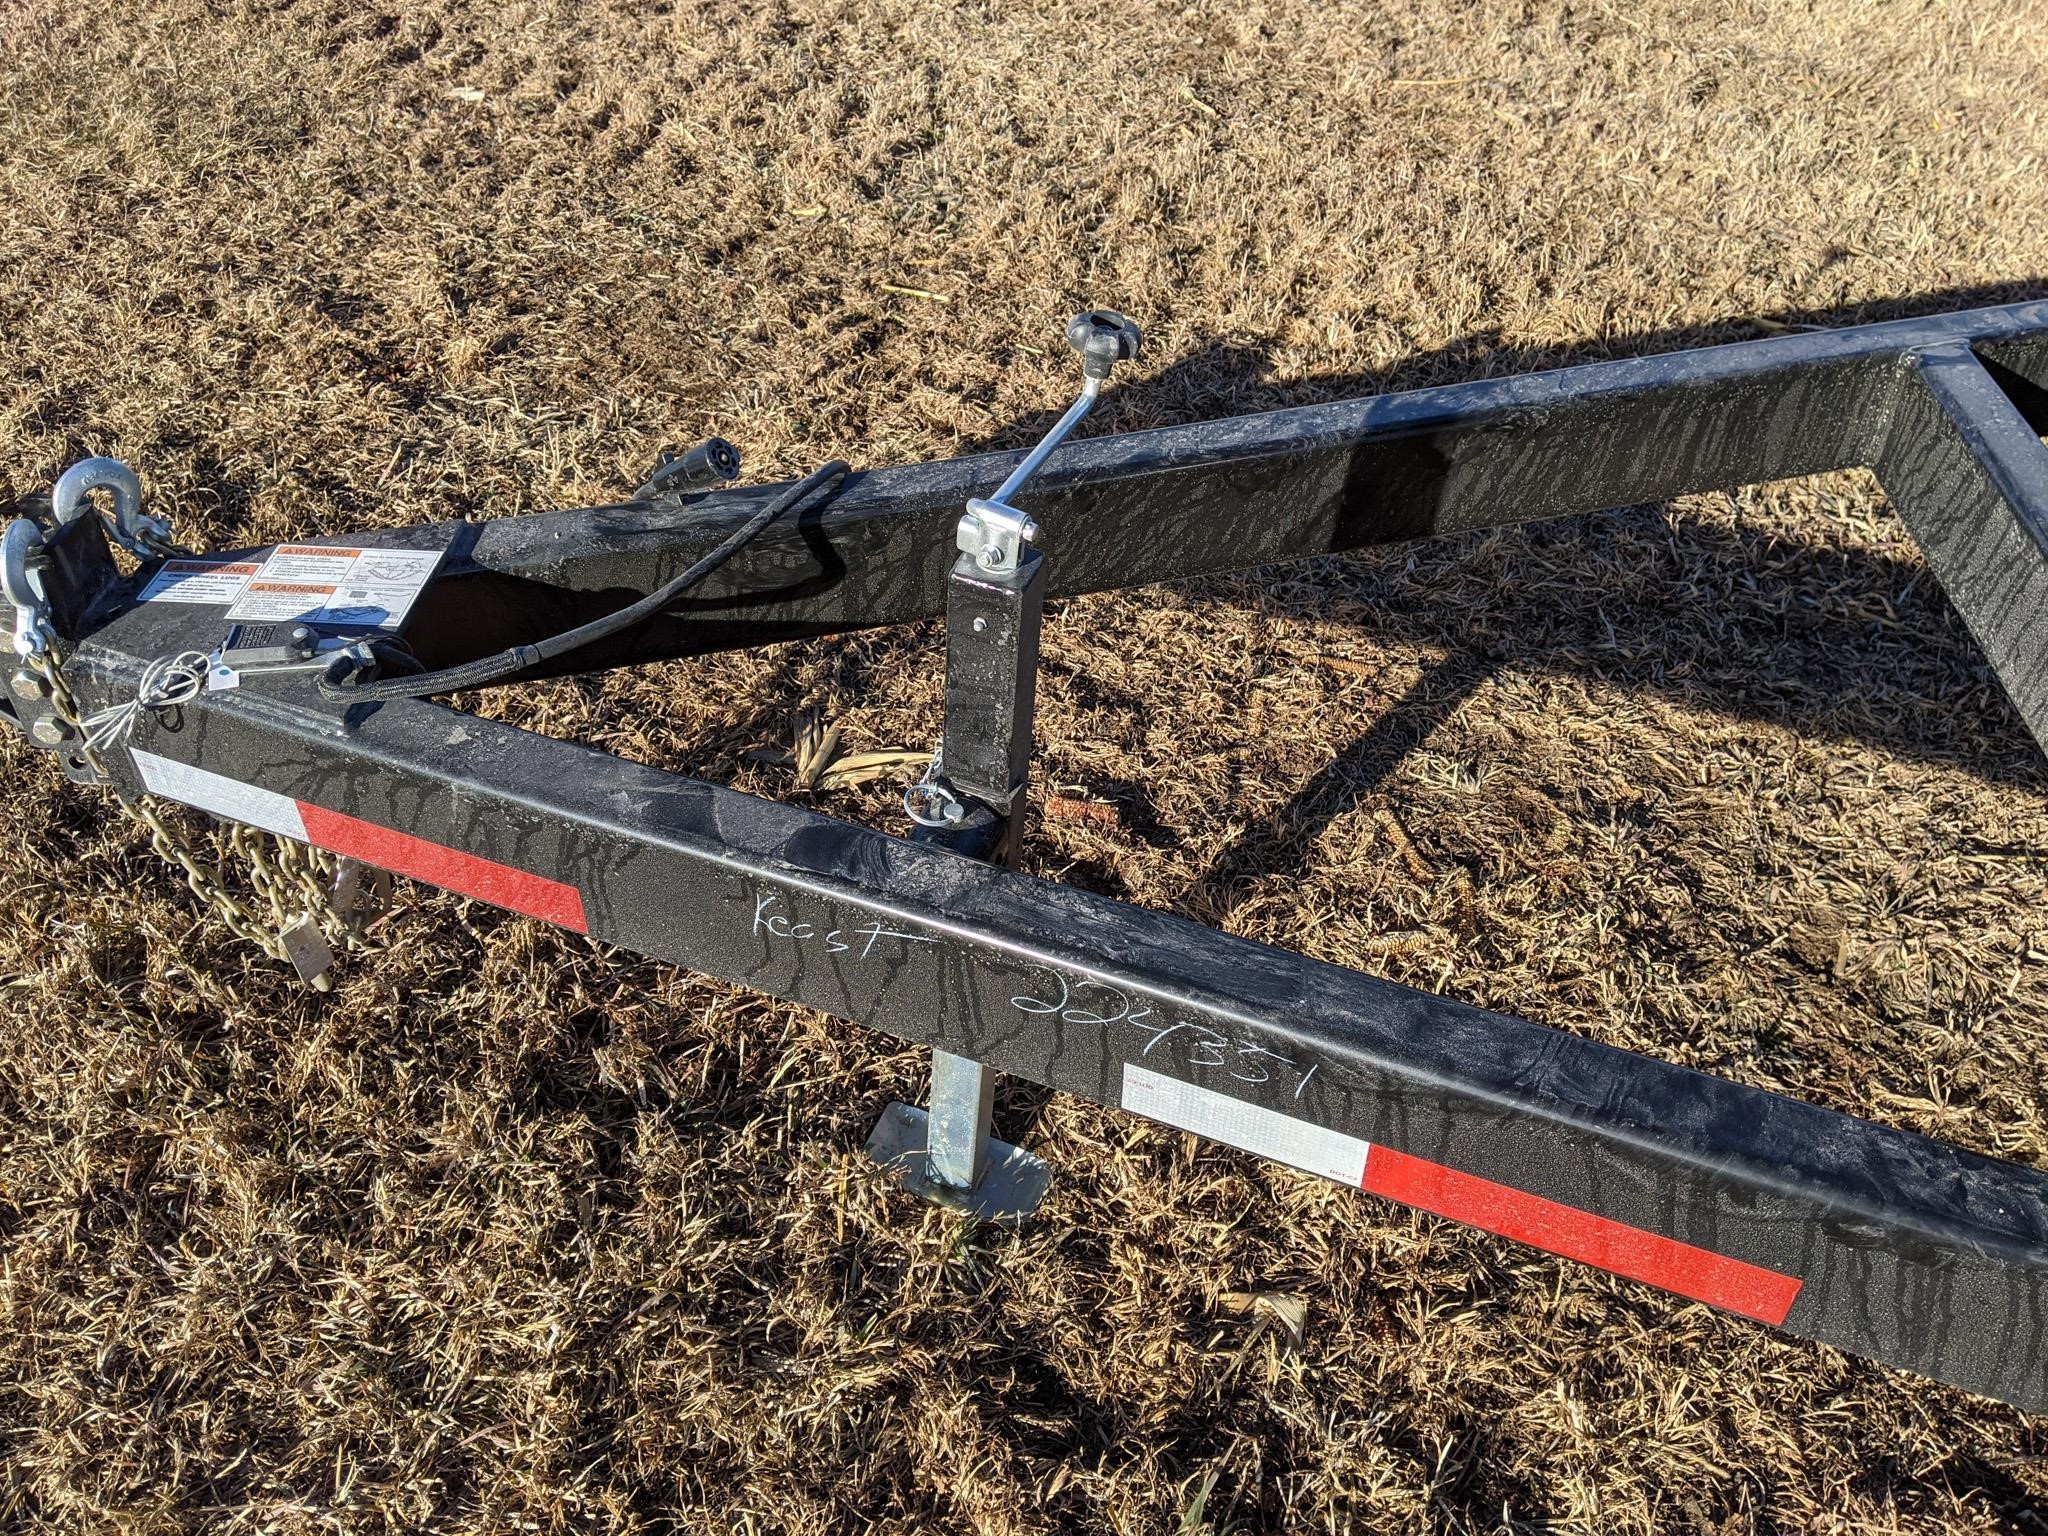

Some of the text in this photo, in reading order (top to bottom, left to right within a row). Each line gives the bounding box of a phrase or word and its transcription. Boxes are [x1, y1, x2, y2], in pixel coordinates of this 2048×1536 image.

[294, 548, 352, 556] WARNING
[184, 562, 249, 573] WARNING
[267, 584, 327, 593] WARNING
